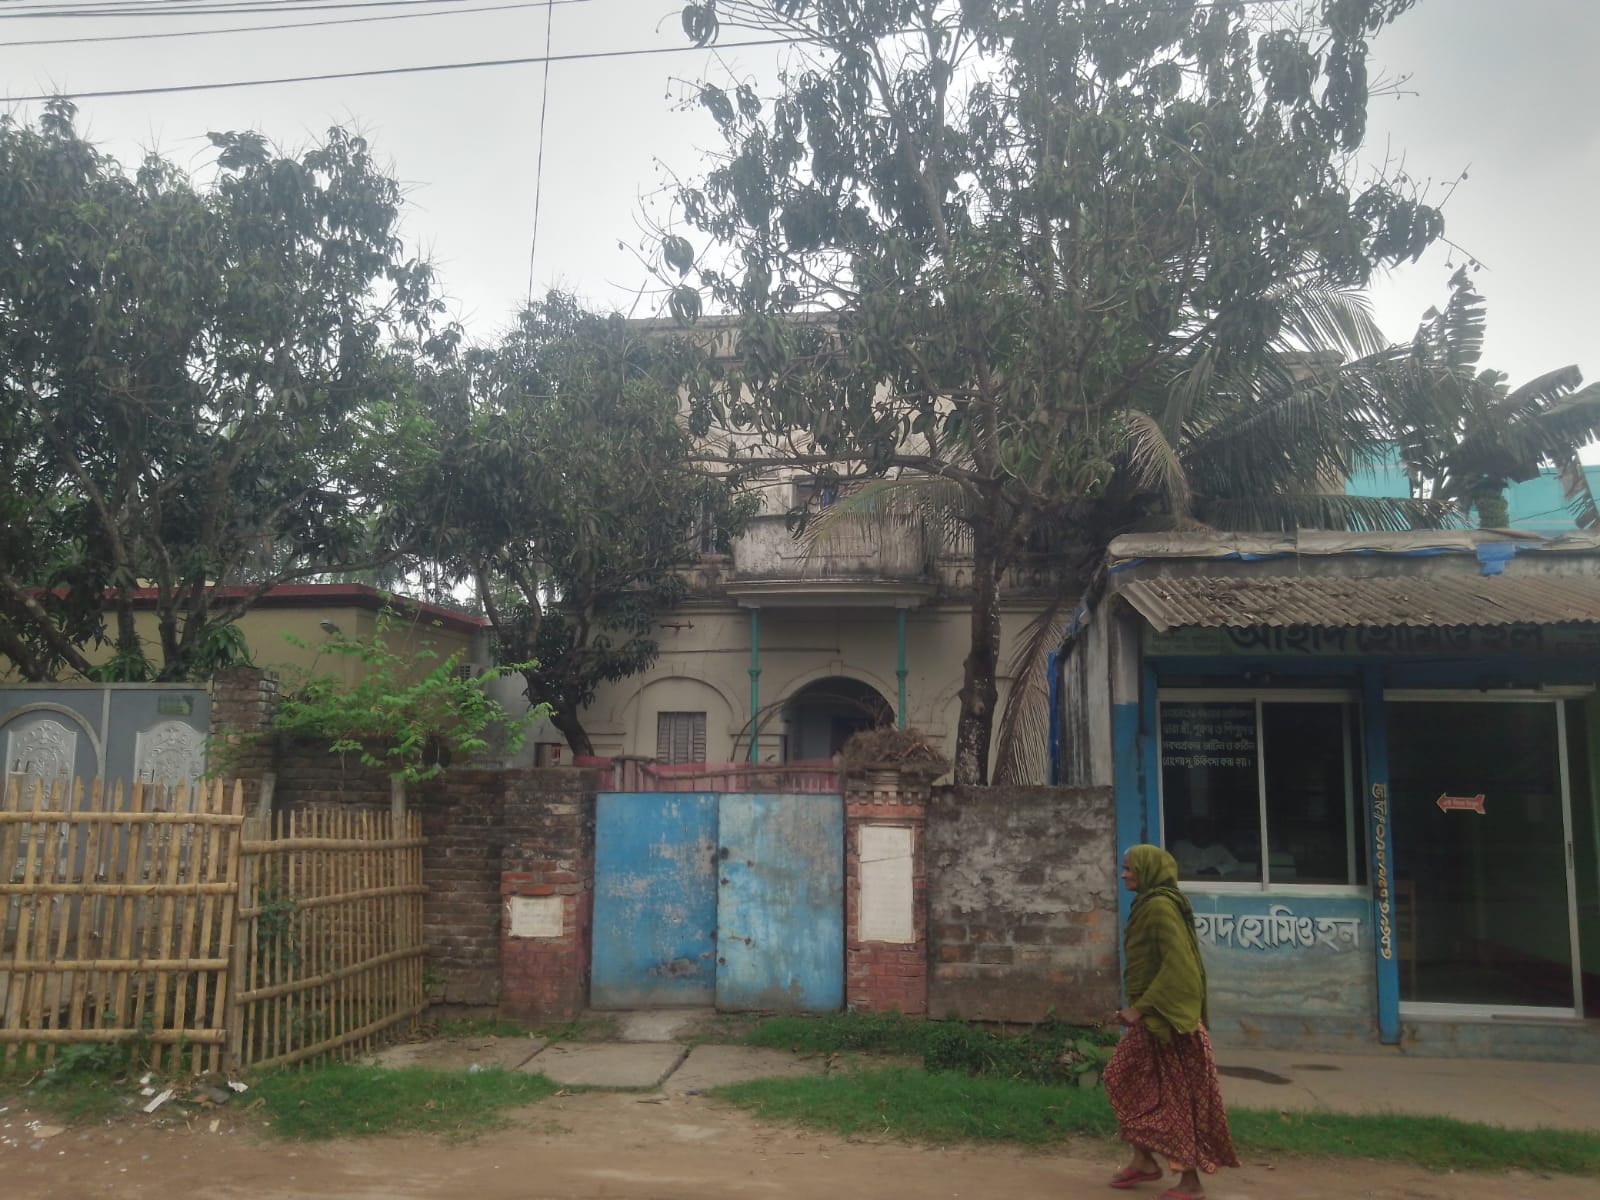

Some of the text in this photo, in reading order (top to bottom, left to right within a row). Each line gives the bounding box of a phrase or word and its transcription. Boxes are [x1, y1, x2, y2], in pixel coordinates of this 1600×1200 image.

[1193, 904, 1361, 951] হাদ হোমিও হল
